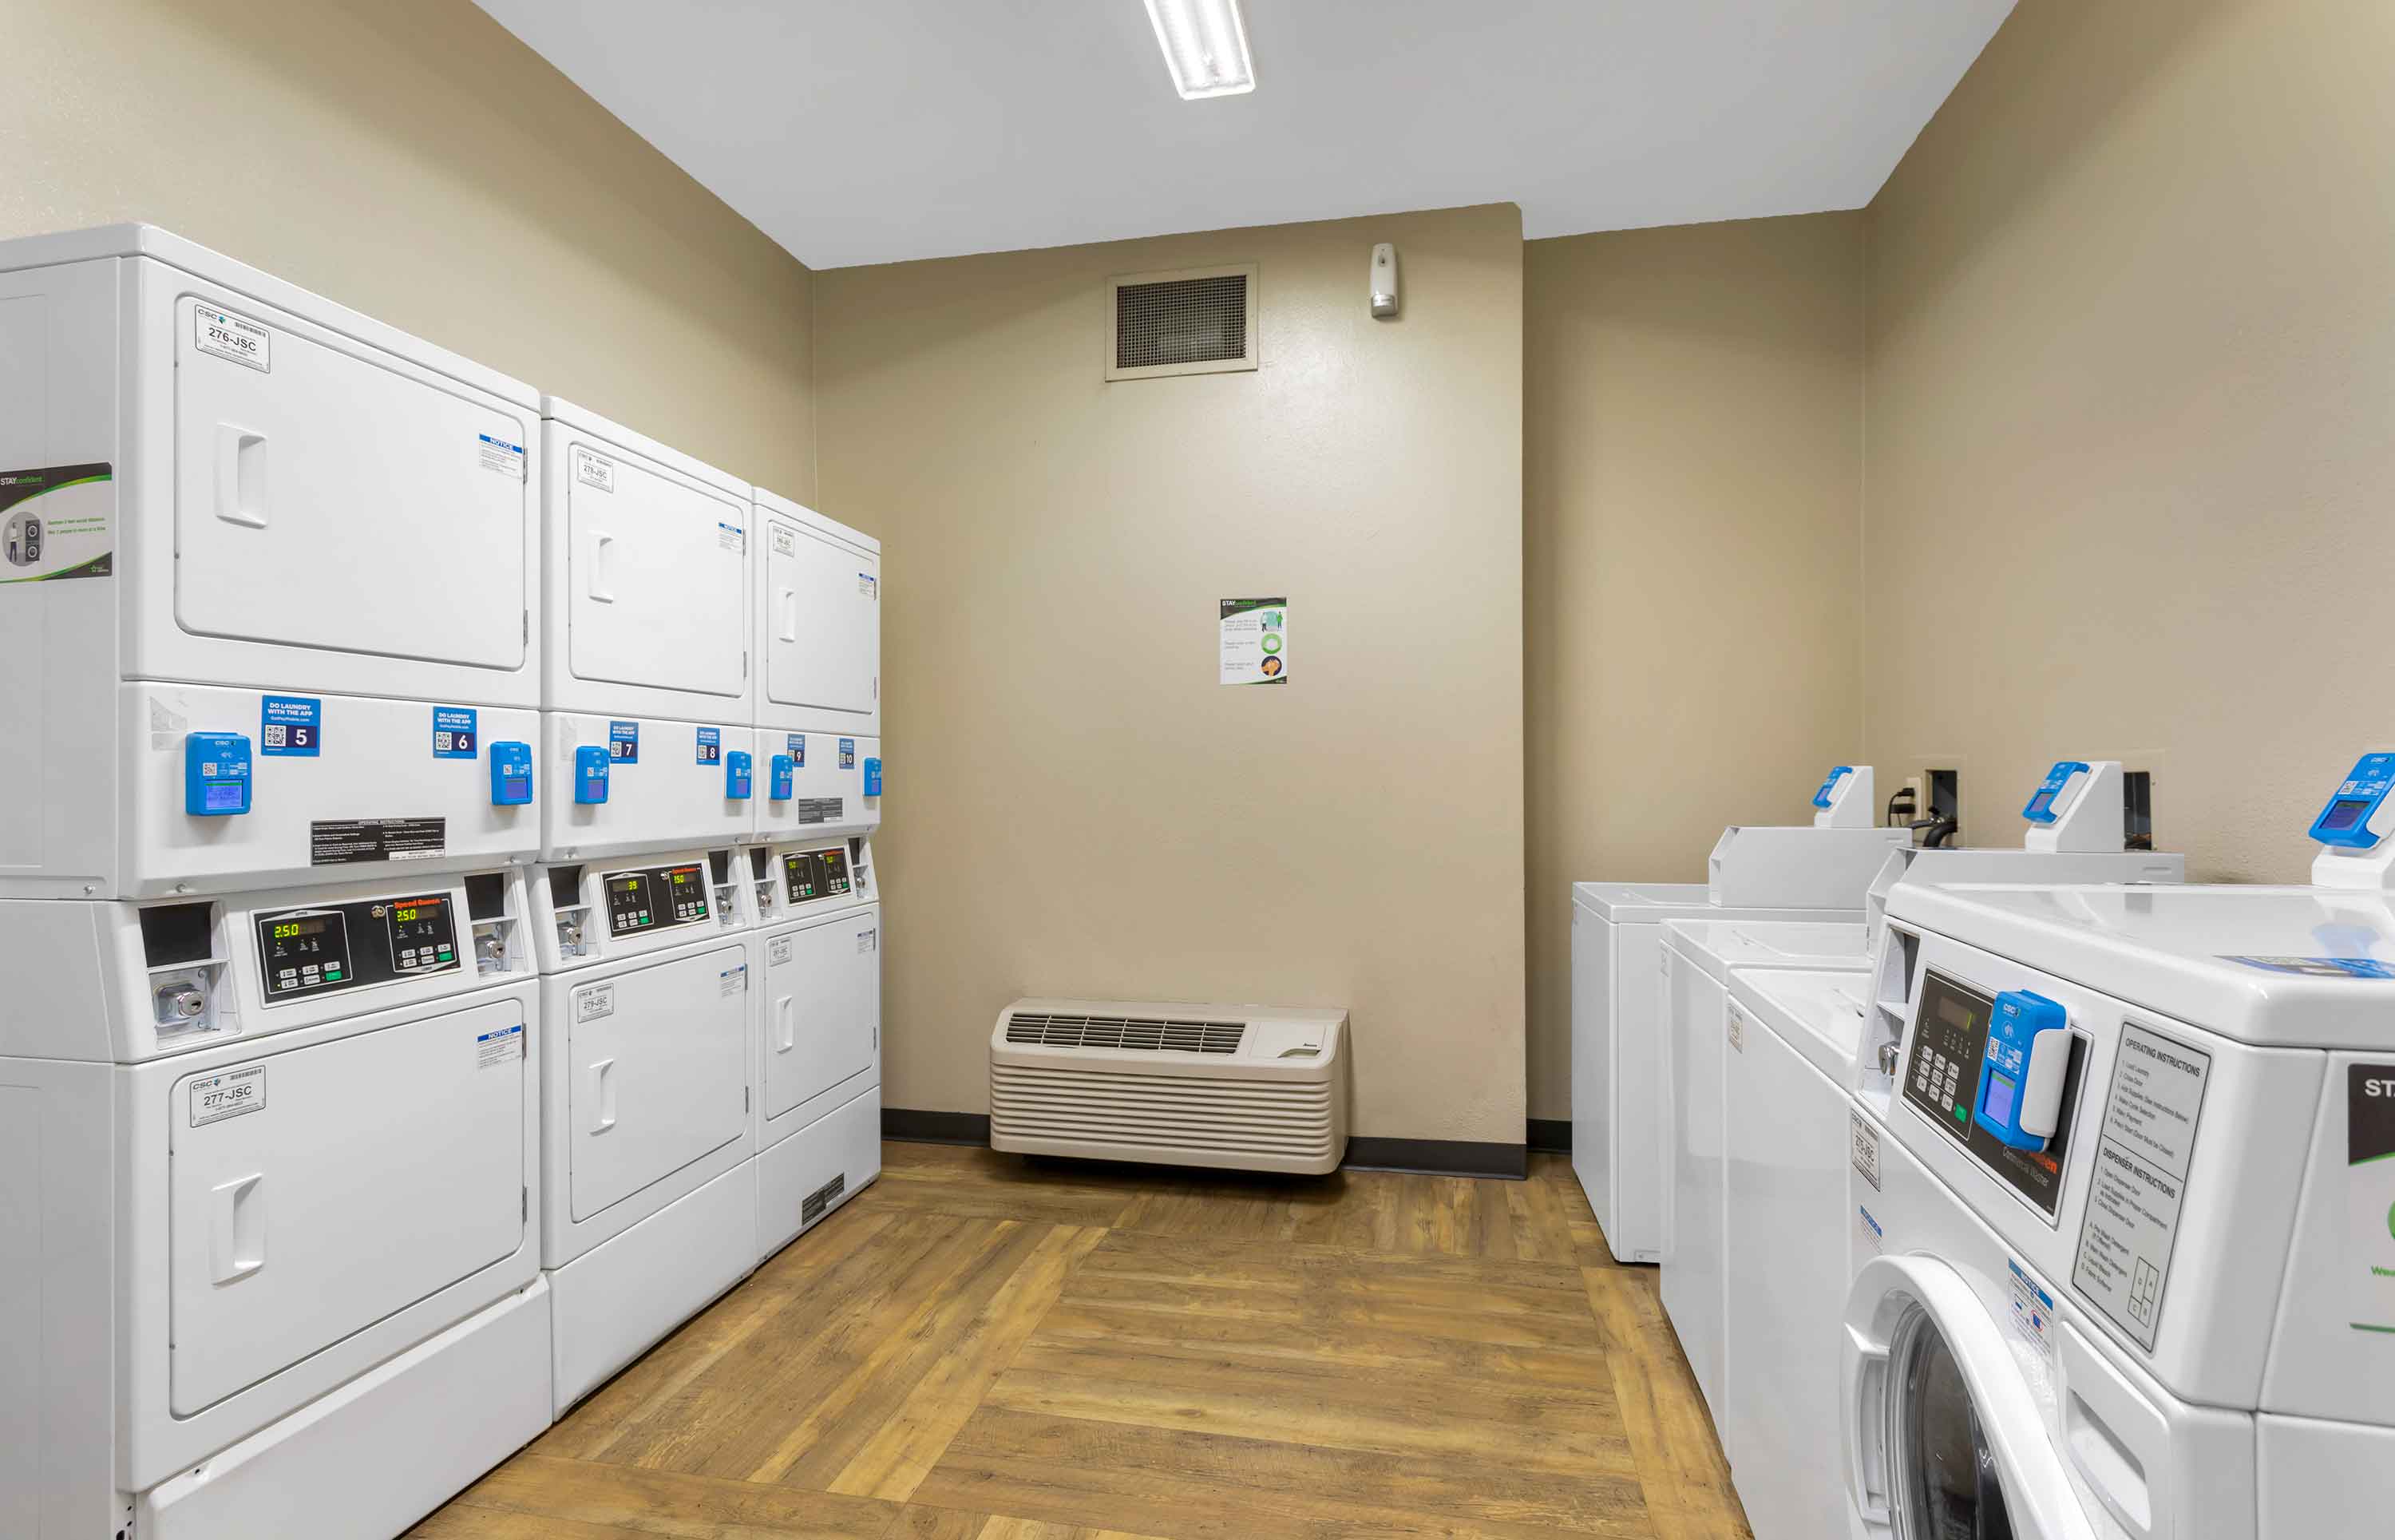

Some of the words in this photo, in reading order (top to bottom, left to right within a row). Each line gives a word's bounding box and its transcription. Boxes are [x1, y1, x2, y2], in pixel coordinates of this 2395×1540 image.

[208, 327, 256, 351] 276-JSC
[295, 729, 307, 746] 5
[458, 734, 468, 750] 6
[626, 743, 632, 756] 7
[710, 747, 715, 758] 8
[797, 751, 802, 761] 9
[846, 754, 853, 764] 10
[394, 900, 418, 909] Speed
[274, 923, 299, 938] 2.50
[2124, 1037, 2156, 1058] OPERATING
[2156, 1050, 2201, 1077] INSTRUCTIONS
[204, 1086, 252, 1107] 277-JSC
[2365, 1079, 2395, 1098] ST
[2103, 1146, 2133, 1173] DISPENSER
[2132, 1164, 2175, 1199] INSTRUCTIONS
